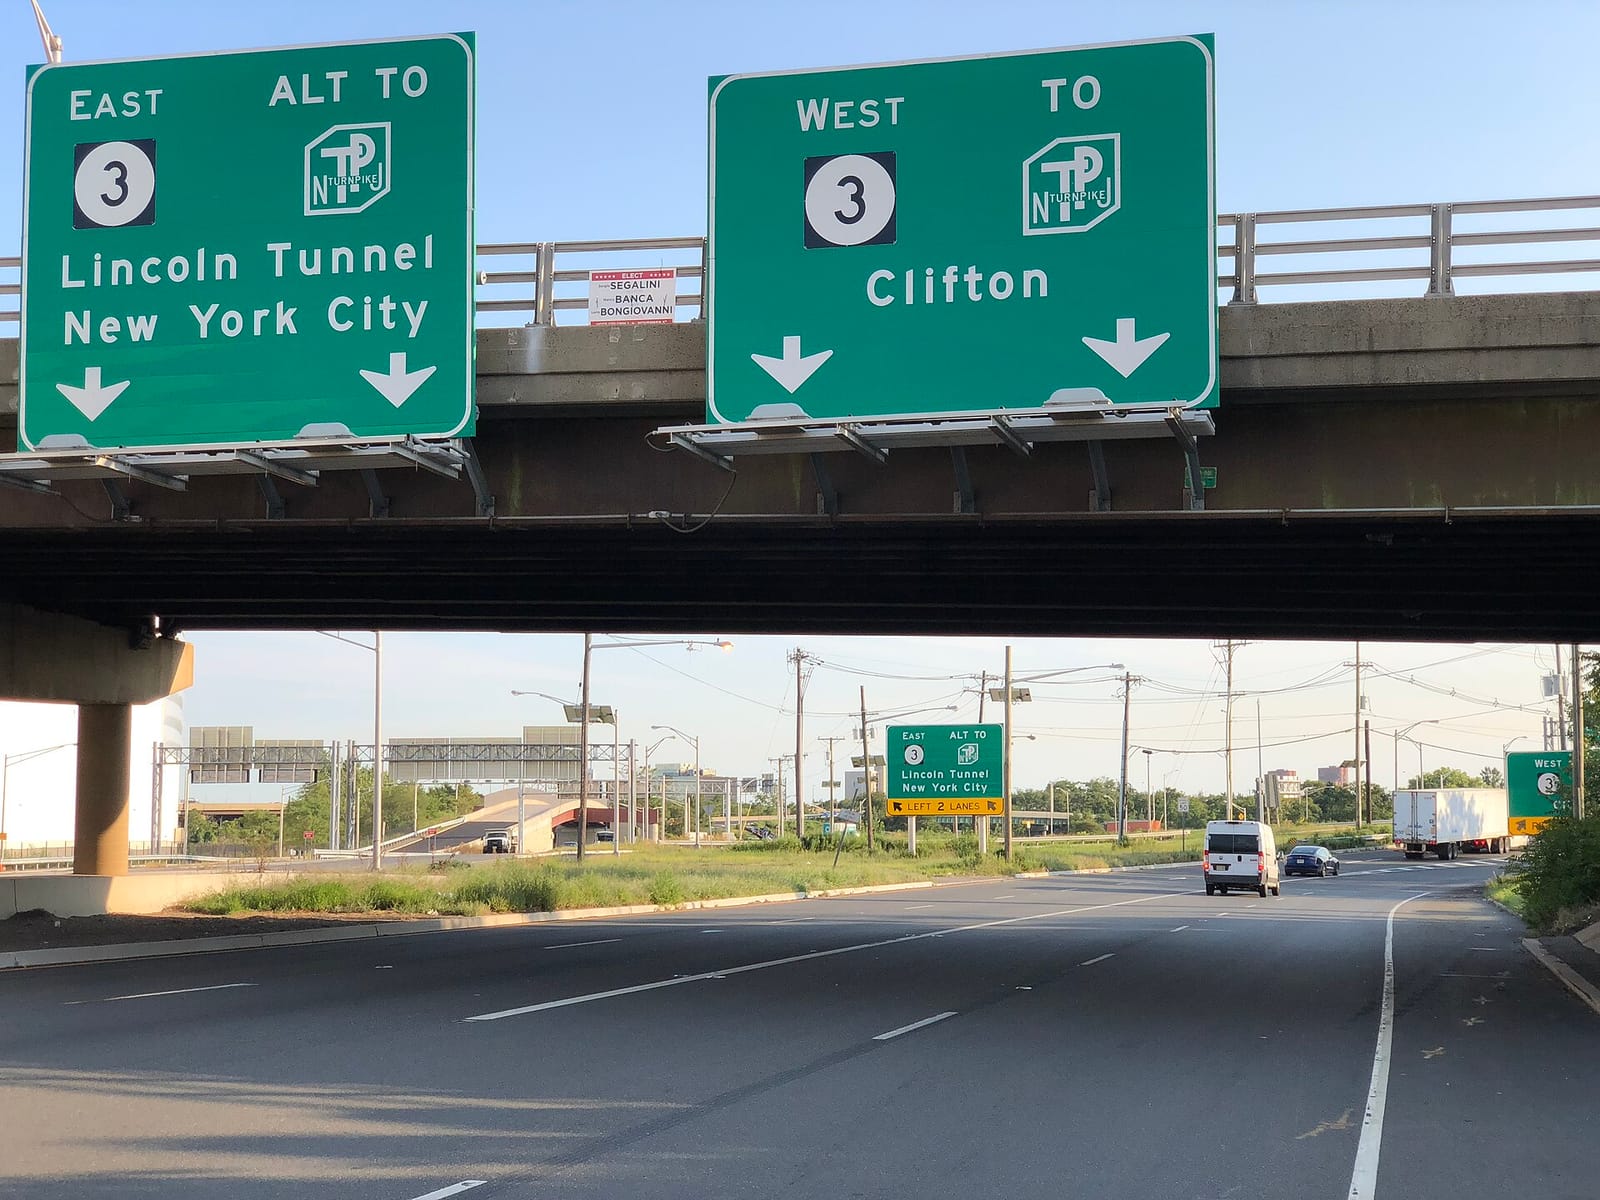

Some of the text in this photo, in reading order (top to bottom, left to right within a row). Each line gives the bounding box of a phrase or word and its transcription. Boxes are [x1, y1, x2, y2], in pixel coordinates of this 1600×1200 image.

[268, 66, 428, 106] ALT TO
[1041, 75, 1101, 111] TO
[70, 89, 163, 120] EAST
[796, 97, 905, 131] WEST
[101, 160, 129, 206] 3
[328, 174, 377, 186] TURNPIKE
[834, 176, 865, 224] 3
[1049, 190, 1106, 203] TURNPIKE
[62, 235, 433, 288] Lincoln Tunnel
[610, 280, 660, 290] SEGALINI
[866, 265, 1048, 307] Clifton
[615, 294, 654, 304] BANCA
[600, 306, 673, 316] BONGIOVANNI
[64, 294, 428, 345] New York City
[902, 732, 925, 740] EAST
[949, 731, 987, 739] ALT TO
[910, 749, 919, 760] 3
[1534, 759, 1562, 768] WEST
[902, 769, 989, 779] Lincoln Tunnel
[902, 782, 988, 794] New York City
[1545, 778, 1553, 790] 3
[907, 802, 980, 812] LEFT 2 LANES
